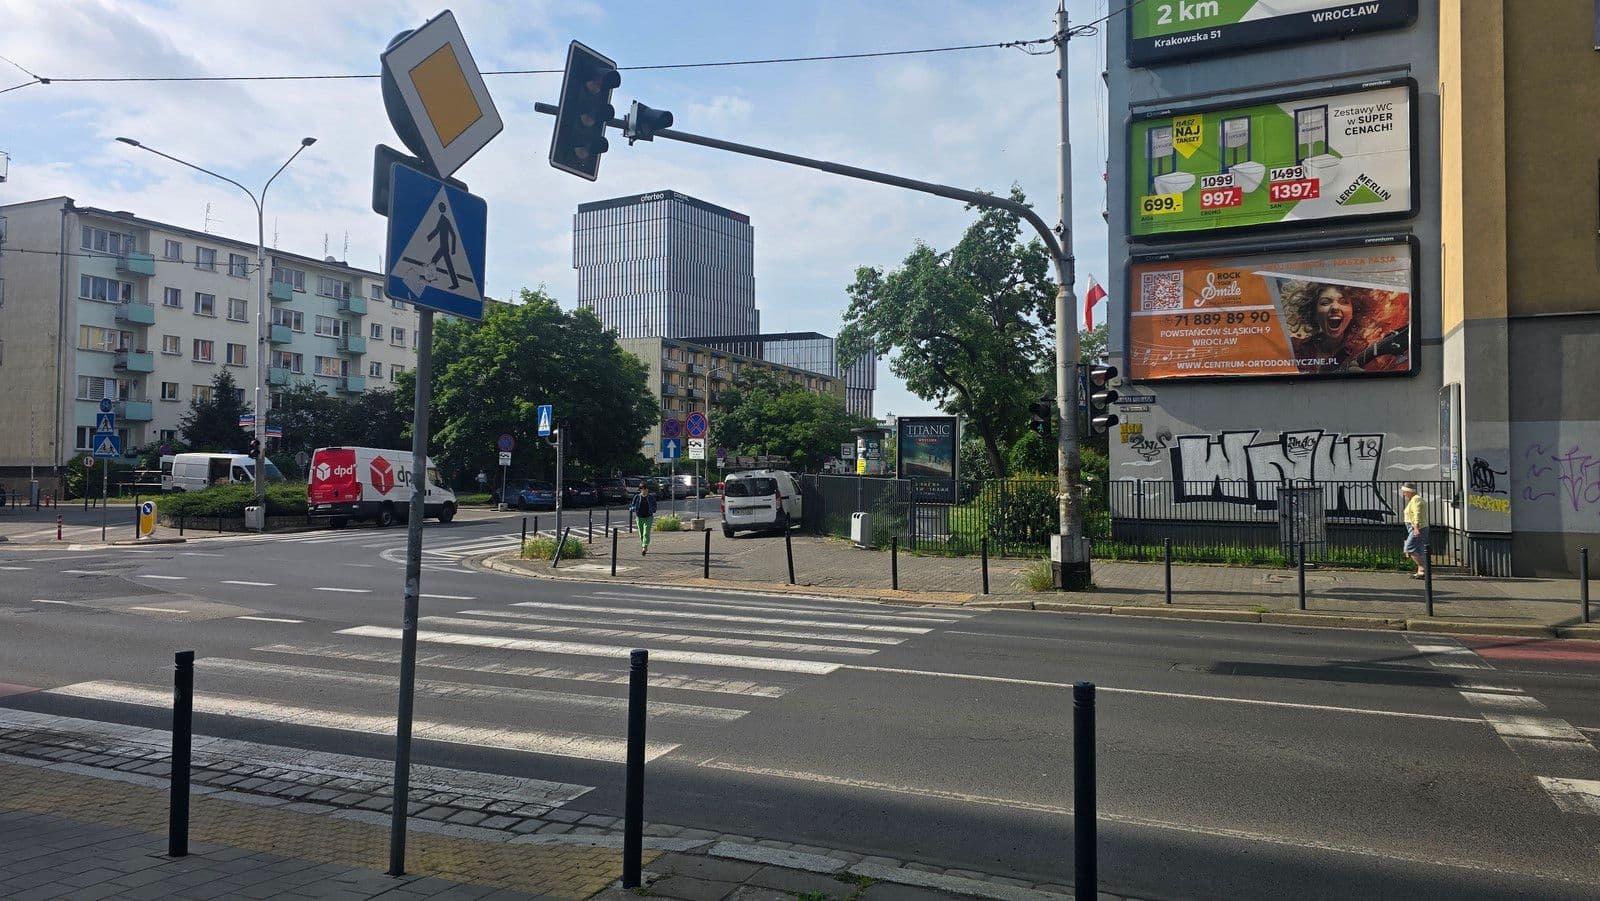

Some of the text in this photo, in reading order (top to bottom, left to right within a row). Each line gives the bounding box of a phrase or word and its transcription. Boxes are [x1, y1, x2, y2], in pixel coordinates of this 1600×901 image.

[1157, 0, 1219, 25] 2 km
[1311, 3, 1380, 23] WROCŁAW
[1154, 30, 1221, 48] Krakowska 51
[1333, 102, 1393, 118] Zestawy WC
[1347, 113, 1393, 126] w SUPER
[1175, 125, 1201, 137] NAJ
[1344, 123, 1393, 136] CENACH!
[1271, 167, 1303, 180] 1499
[1201, 176, 1233, 188] 1099
[1357, 173, 1392, 201] MERLIN
[1335, 180, 1361, 206] LEROY
[1143, 197, 1181, 212] 699,-
[1217, 271, 1241, 280] ROCK
[1174, 311, 1271, 326] 71 889 89 90
[1160, 327, 1222, 338] POWSTAŃCÓW
[1265, 326, 1271, 334] 9
[1192, 337, 1238, 347] WROCŁAW
[1177, 357, 1339, 370] WWW.CENTRUM-ORTODONTYCZNE.PL
[906, 424, 950, 435] TITANIC
[333, 464, 353, 478] dpd
[397, 465, 414, 487] dp
